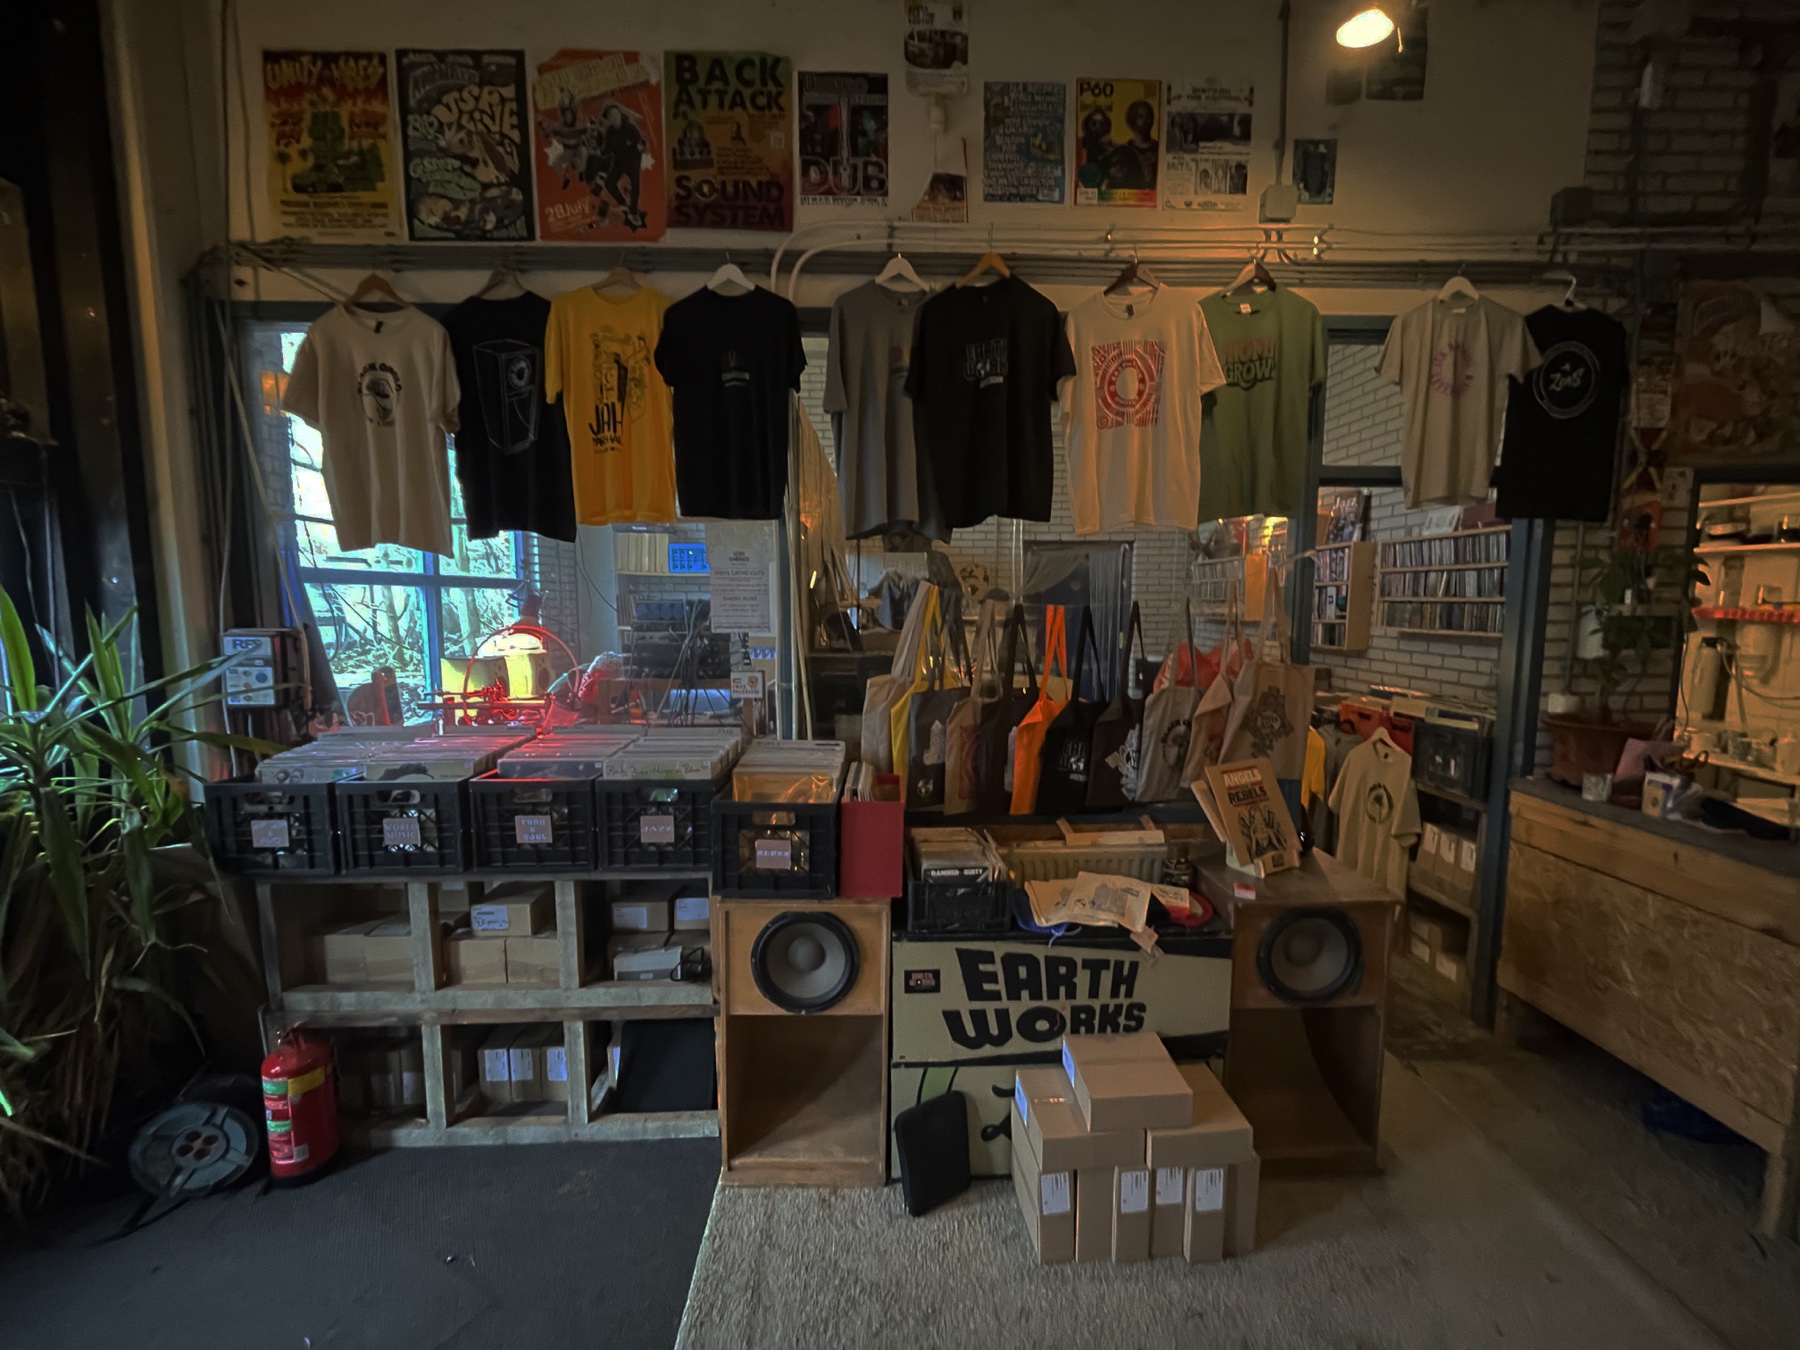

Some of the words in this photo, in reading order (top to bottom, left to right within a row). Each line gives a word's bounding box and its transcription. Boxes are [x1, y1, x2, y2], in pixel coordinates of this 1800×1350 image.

[675, 54, 784, 88] BACK
[673, 86, 785, 113] ATTACK
[1080, 82, 1113, 97] P60
[800, 156, 888, 195] DUB
[675, 175, 784, 202] SOUND
[675, 202, 785, 226] SYSTEM
[1223, 768, 1262, 787] ANGELS
[1228, 785, 1268, 804] REBELS
[384, 823, 418, 831] WORLD
[386, 831, 415, 839] MUSIC
[955, 948, 1140, 1001] EARTH
[942, 1002, 1147, 1049] WORKS
